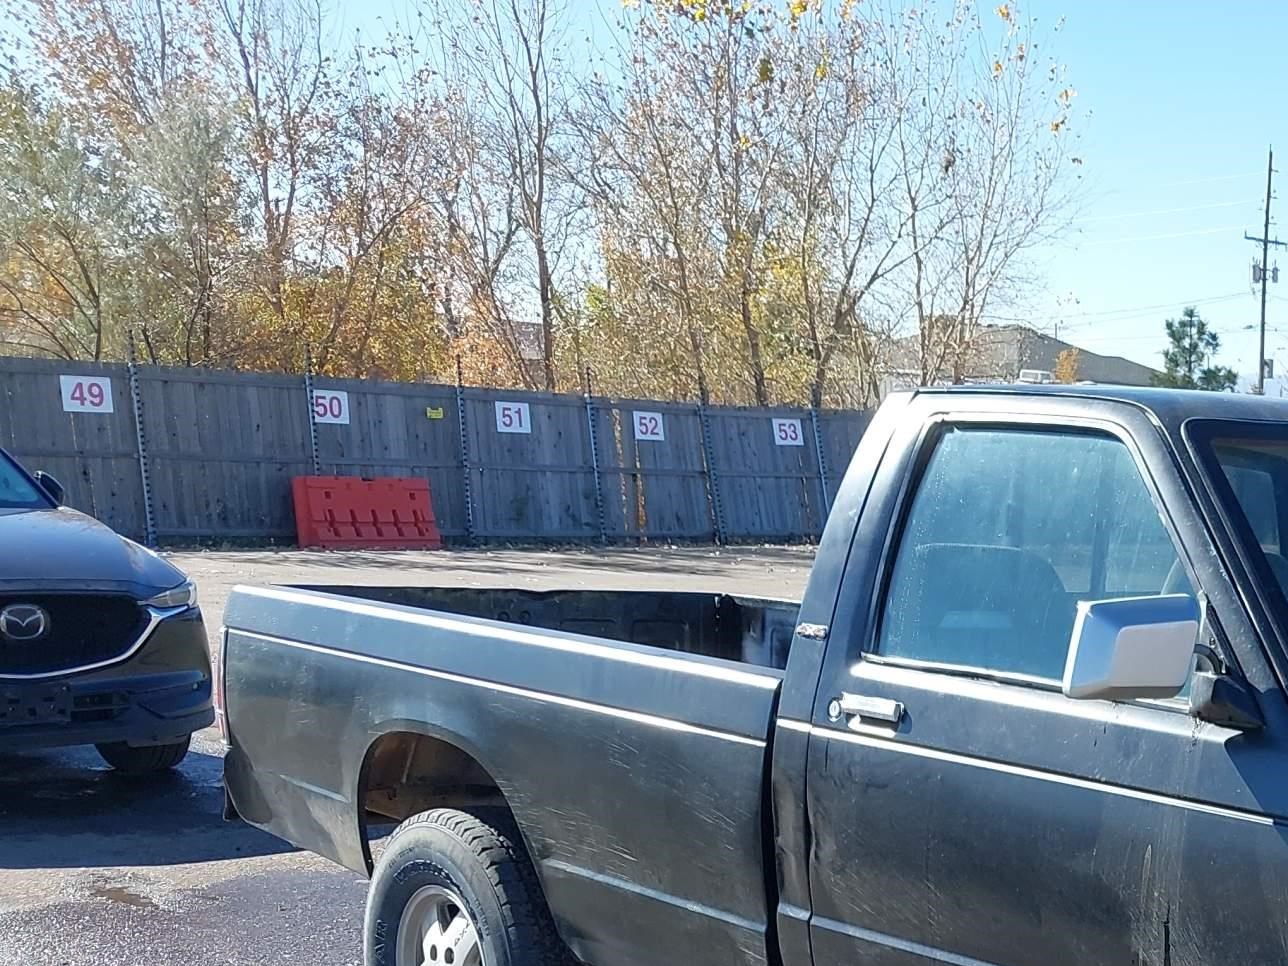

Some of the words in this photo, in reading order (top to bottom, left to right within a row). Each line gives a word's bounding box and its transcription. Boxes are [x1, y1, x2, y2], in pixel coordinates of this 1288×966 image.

[69, 382, 105, 407] 49
[314, 395, 342, 419] 50
[501, 406, 525, 428] 51
[638, 416, 660, 436] 52
[778, 422, 799, 442] 53
